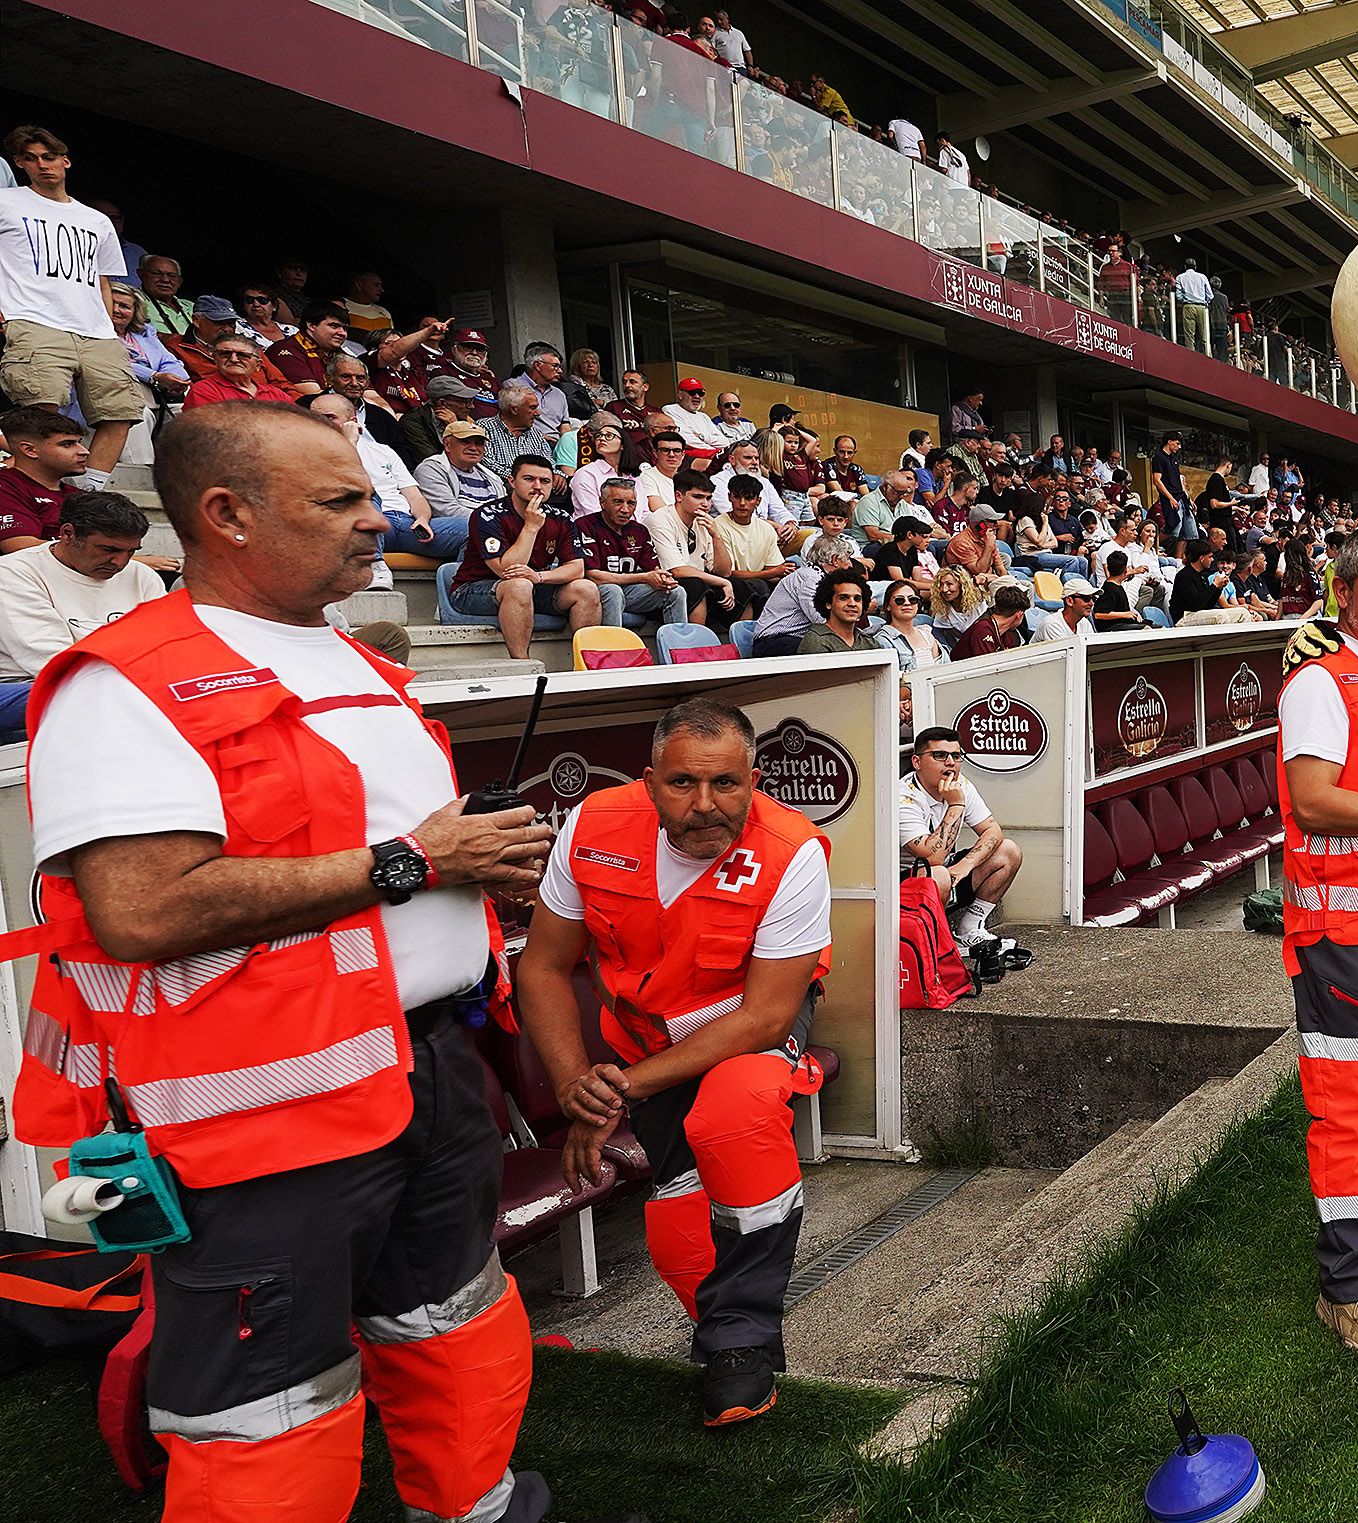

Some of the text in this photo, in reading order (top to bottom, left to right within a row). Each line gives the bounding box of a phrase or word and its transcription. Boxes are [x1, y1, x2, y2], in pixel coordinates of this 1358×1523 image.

[22, 216, 98, 287] VLONE
[967, 273, 1001, 298] XUNTA
[968, 292, 1023, 322] DE GALICIA
[1093, 320, 1118, 341] XUNTA
[1094, 335, 1133, 361] DE GALICIA
[196, 675, 257, 691] Socorrista
[1232, 682, 1258, 700] Estrella
[1125, 699, 1162, 722] Estrella
[970, 714, 1029, 733] Estrella
[1127, 717, 1160, 742] Galicia
[972, 732, 1027, 751] Galicia
[758, 754, 838, 777] Estrella
[763, 778, 836, 801] Galicia
[590, 851, 626, 866] Socorrista
